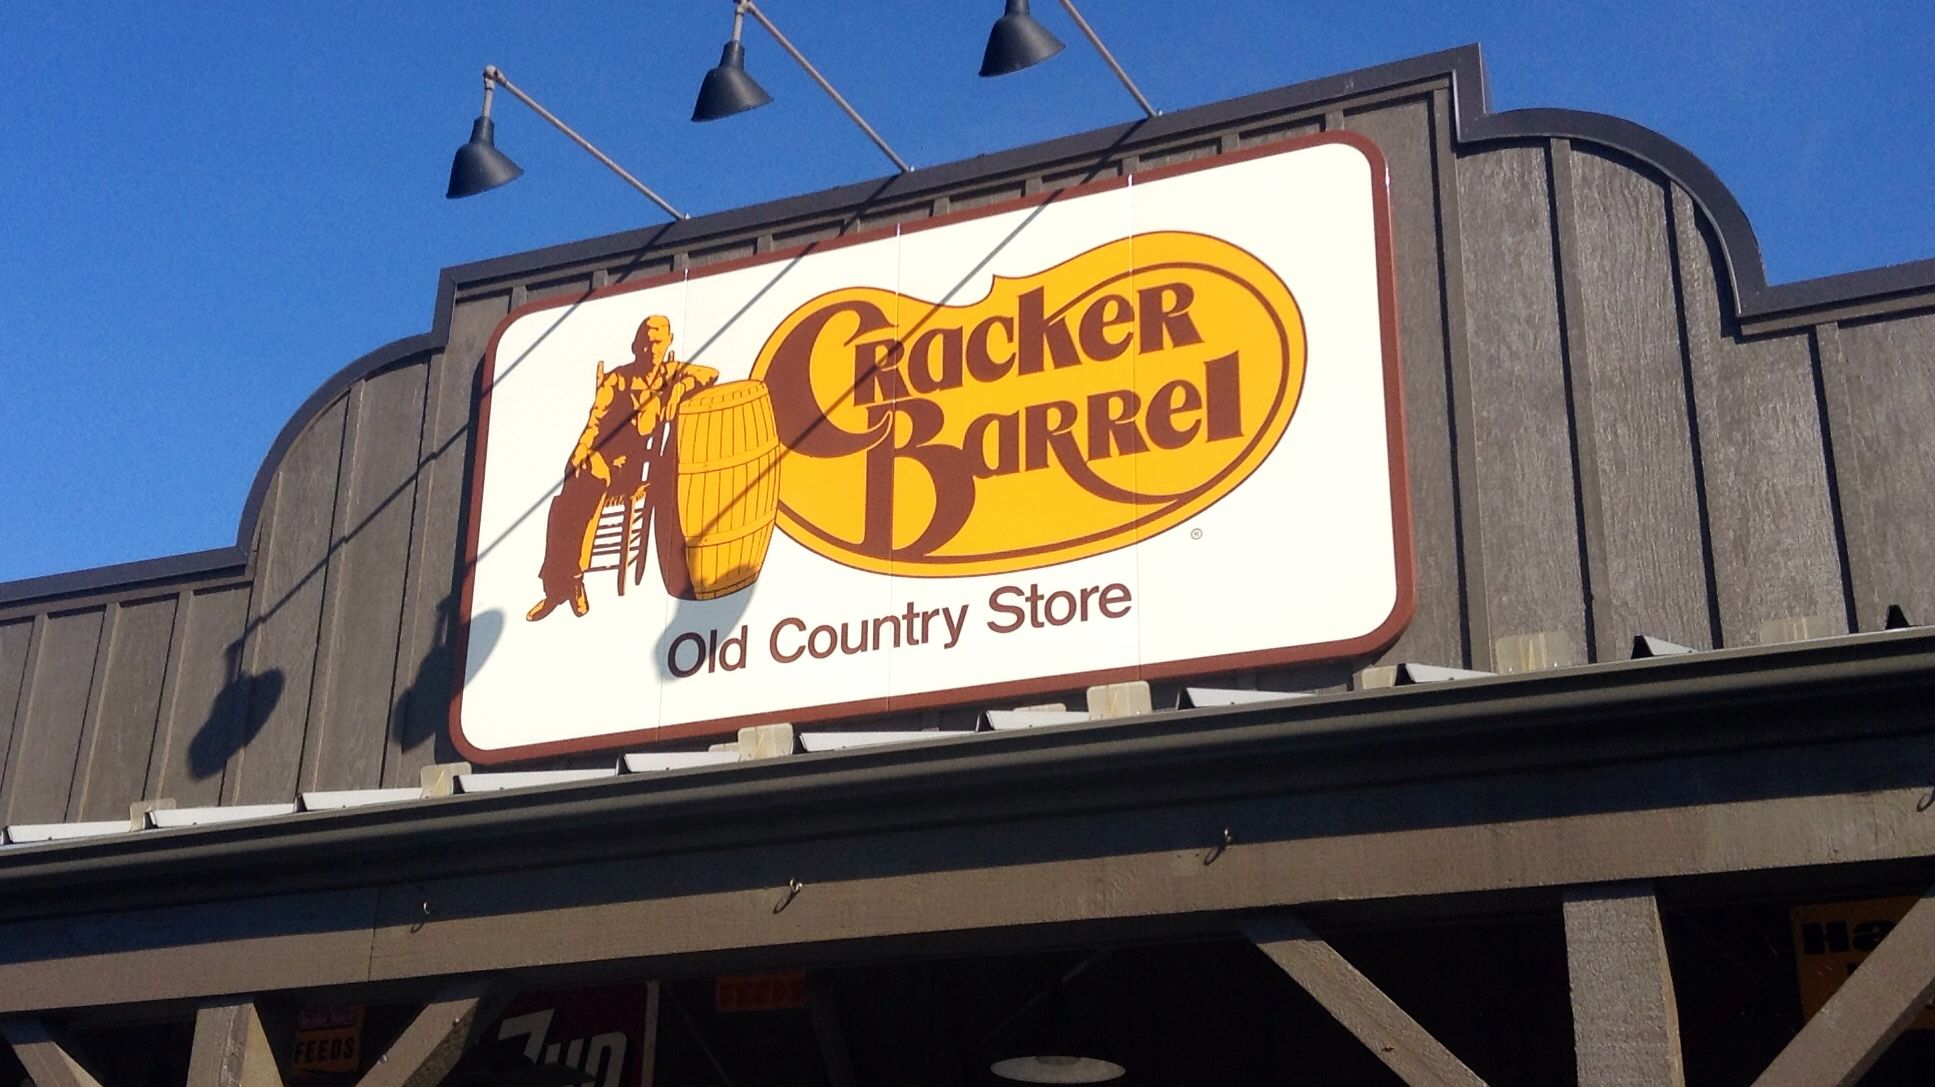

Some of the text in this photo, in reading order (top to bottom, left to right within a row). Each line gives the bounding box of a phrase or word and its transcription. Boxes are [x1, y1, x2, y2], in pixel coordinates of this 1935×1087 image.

[667, 582, 1133, 678] Old Country Store
[294, 1036, 355, 1063] FEEDS
